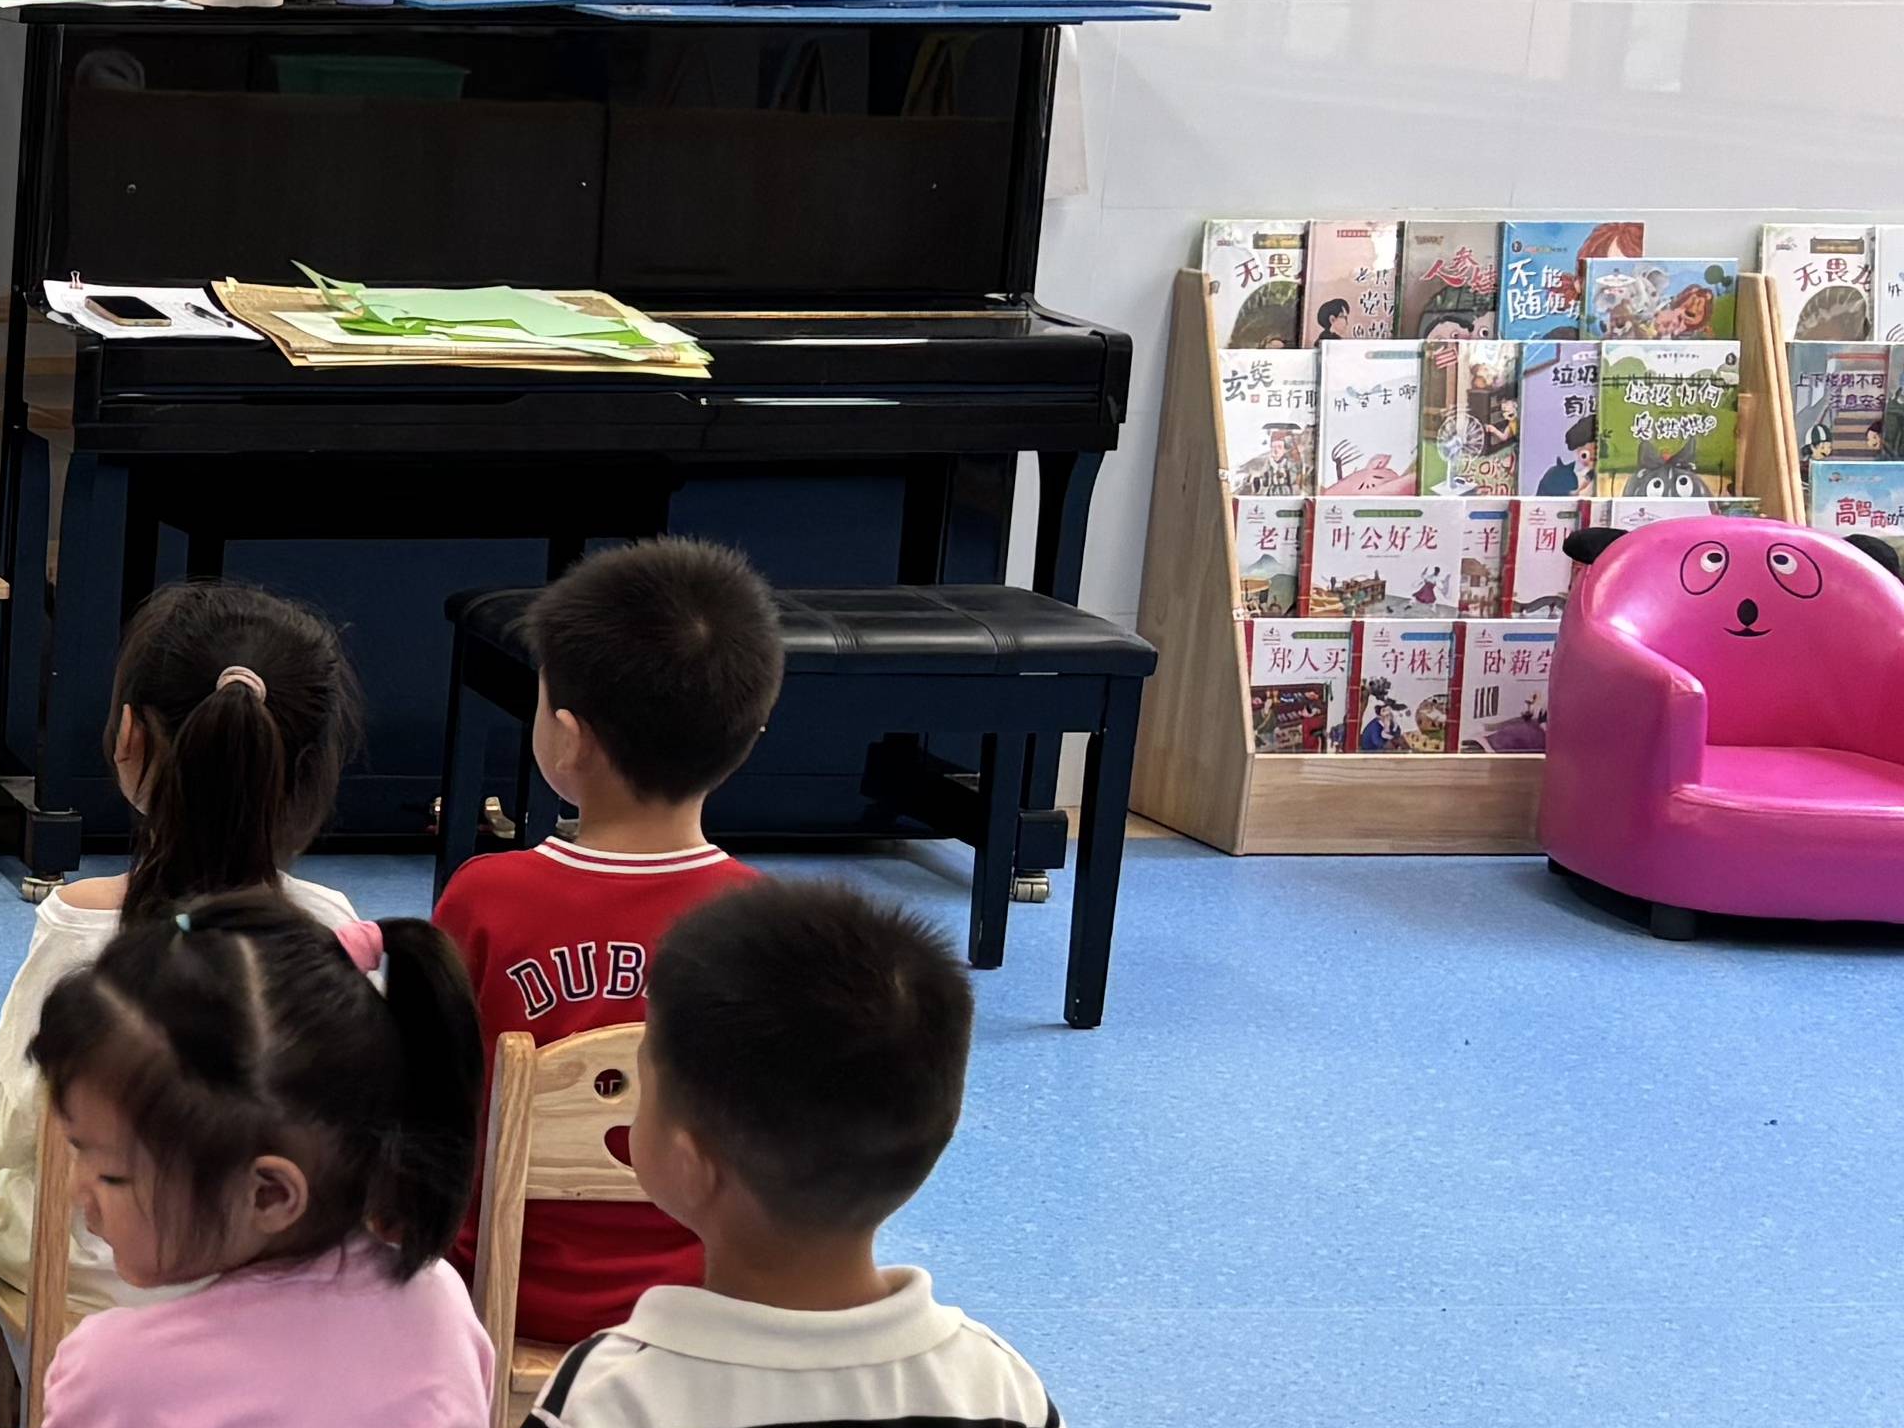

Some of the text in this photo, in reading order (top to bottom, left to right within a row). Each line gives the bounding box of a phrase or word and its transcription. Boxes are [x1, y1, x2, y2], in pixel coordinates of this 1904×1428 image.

[1507, 258, 1564, 289] 不能
[1330, 524, 1439, 552] 叶公好龙
[506, 940, 649, 1021] DUB
